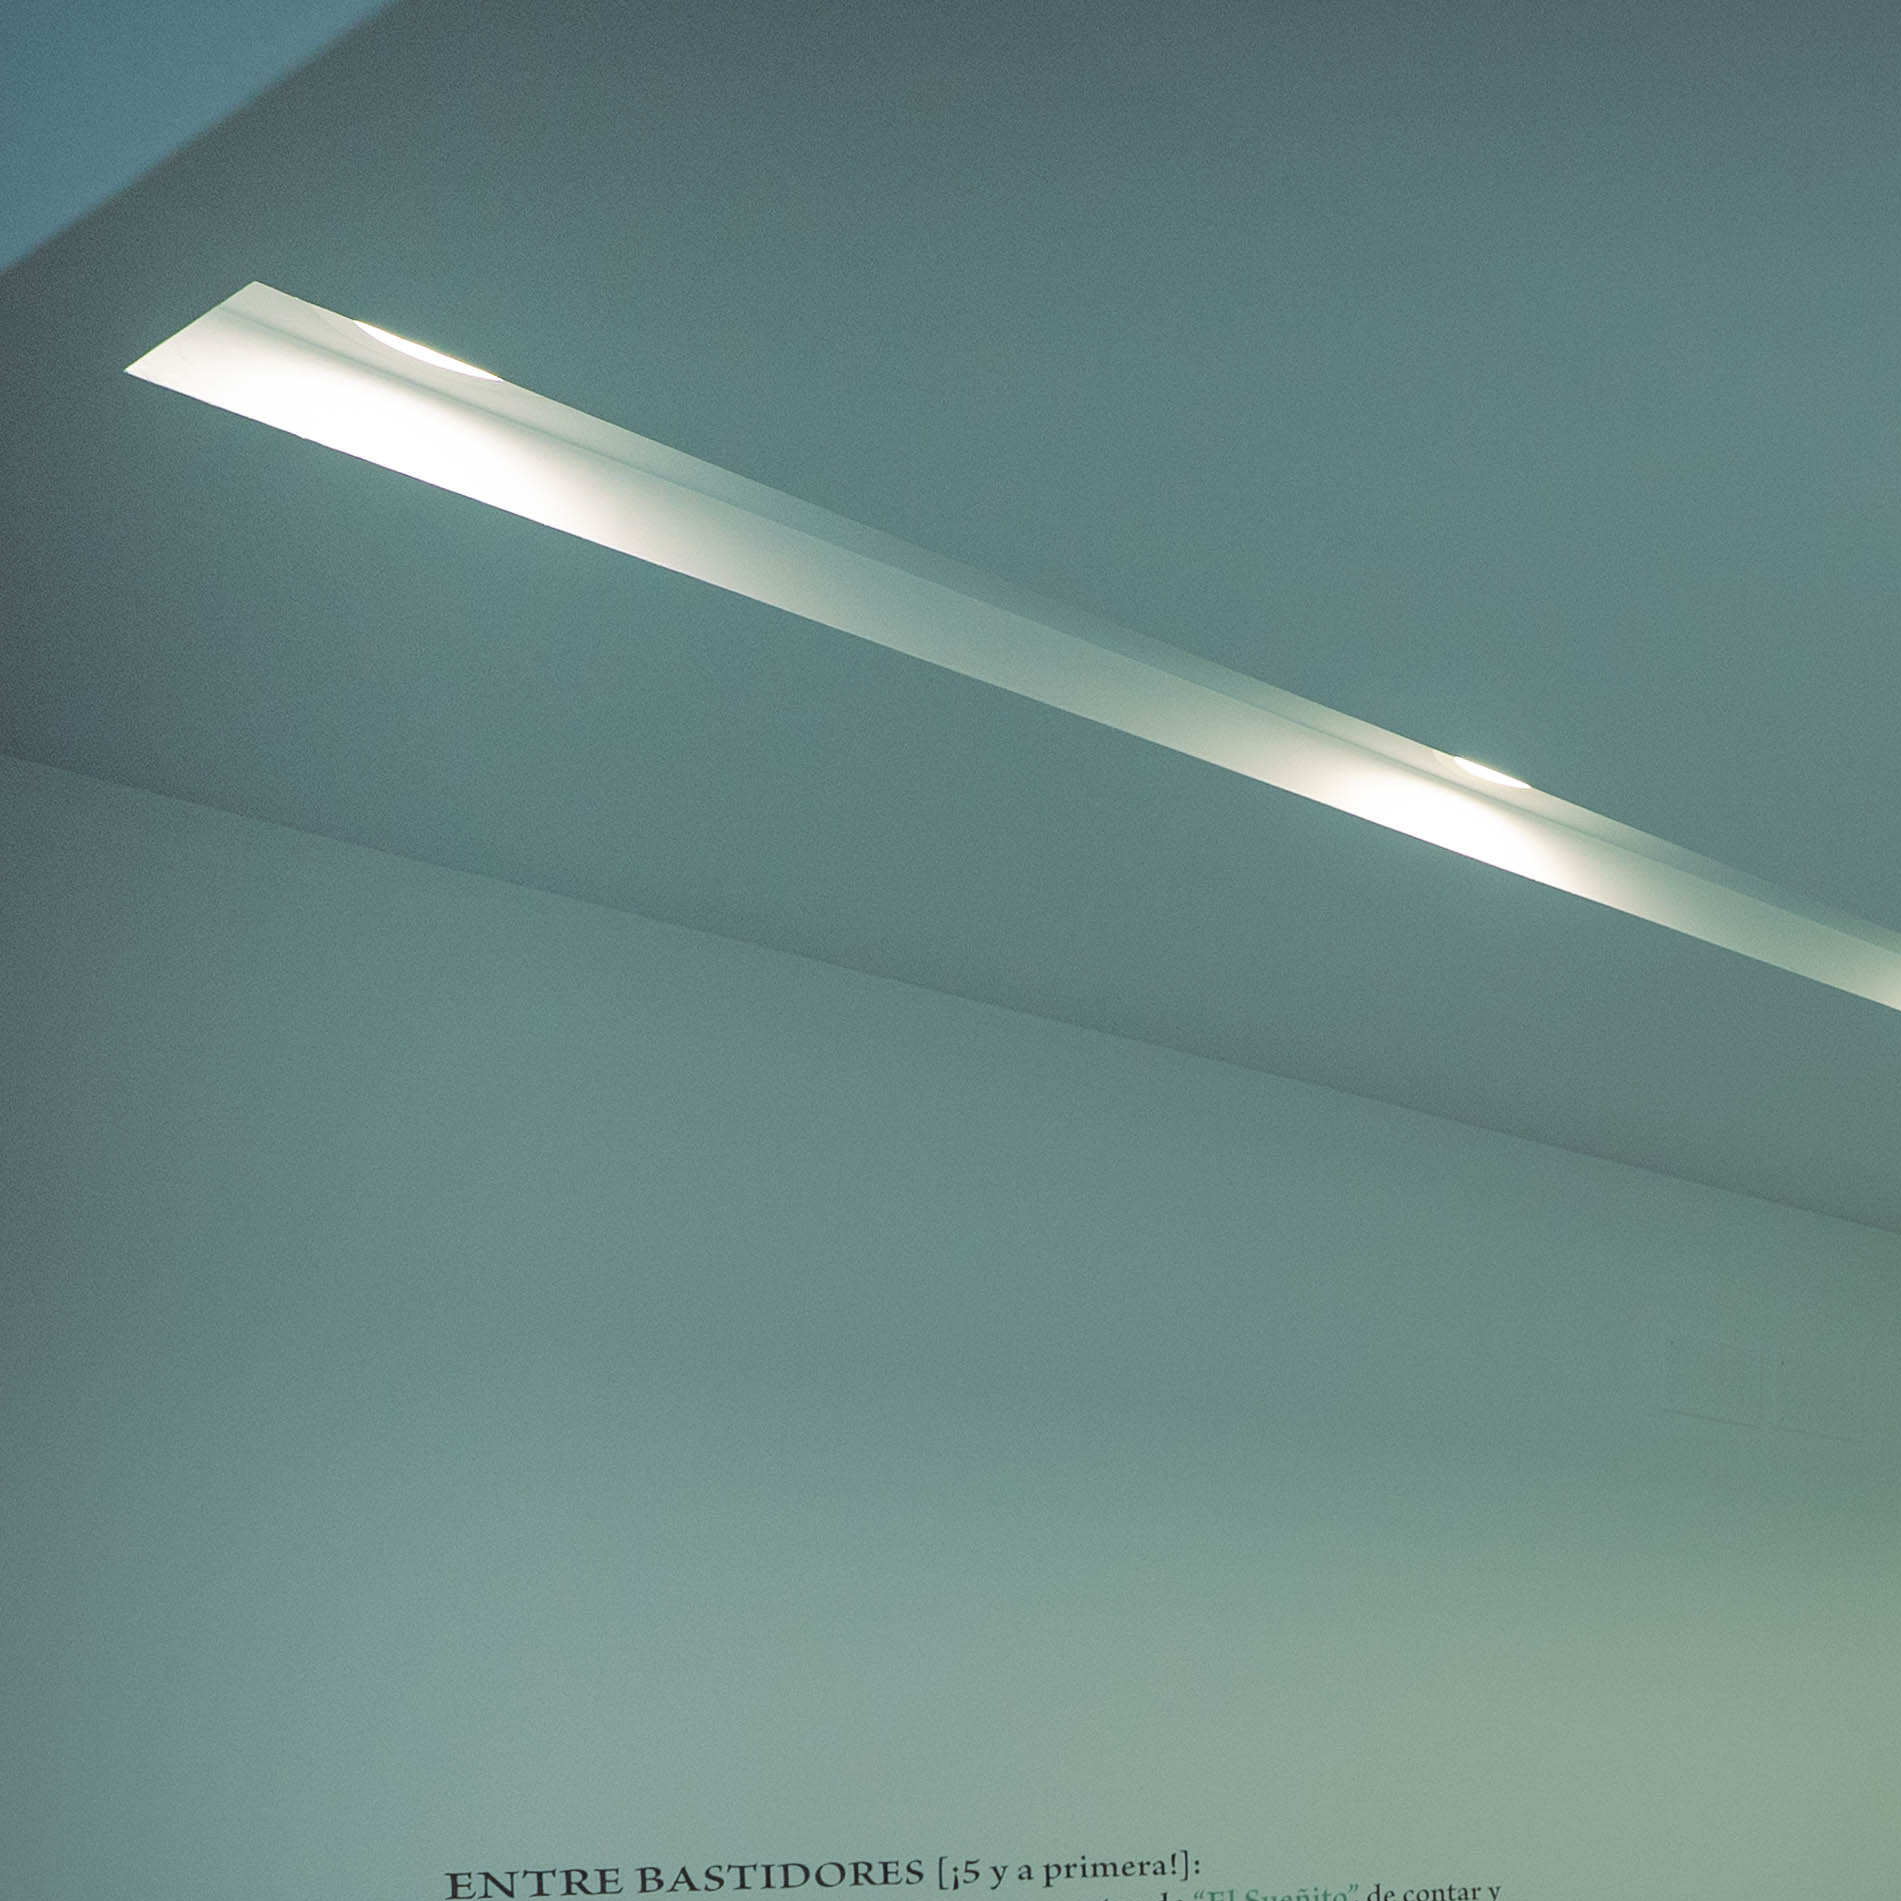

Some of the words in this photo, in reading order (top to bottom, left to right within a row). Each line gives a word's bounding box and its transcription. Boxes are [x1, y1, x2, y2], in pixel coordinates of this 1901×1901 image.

[444, 1867, 624, 1901] ENTRE
[635, 1858, 925, 1894] BASTIDORES
[989, 1864, 1009, 1891] y
[1017, 1863, 1035, 1881] a
[1042, 1849, 1201, 1889] primera!]:
